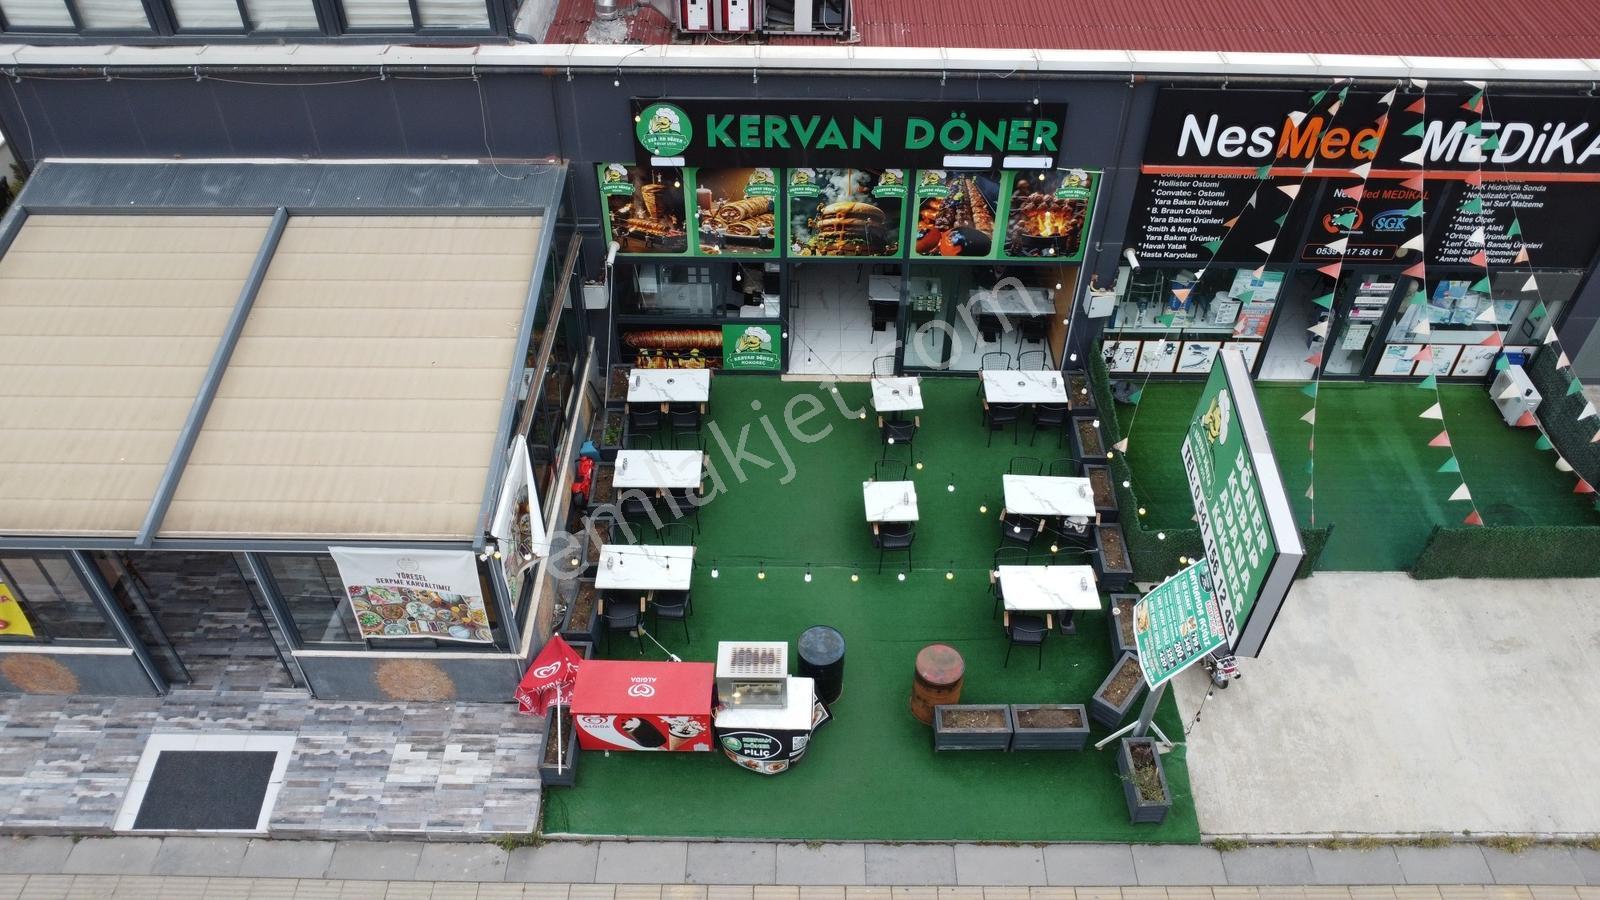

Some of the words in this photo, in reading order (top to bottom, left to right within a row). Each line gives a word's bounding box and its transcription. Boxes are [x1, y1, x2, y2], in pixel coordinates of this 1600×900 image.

[706, 114, 883, 150] KERVAN
[905, 112, 1058, 153] DÖNER
[1198, 198, 1229, 206] Ürünleri
[1194, 216, 1224, 224] Ürünleri
[1375, 217, 1408, 230] SGK
[1190, 234, 1221, 242] Ürünleri
[1486, 241, 1512, 250] Bandaj
[1164, 252, 1198, 260] Karyolası
[1235, 444, 1268, 556] DÖNER
[1228, 468, 1259, 569] KEBAP
[1184, 444, 1196, 486] TEL:
[1194, 485, 1200, 500] 0
[1198, 500, 1209, 535] 541
[1208, 539, 1220, 576] 156
[1218, 579, 1227, 606] 12
[1225, 610, 1234, 636] 48
[1219, 488, 1251, 594] ADANA
[1211, 501, 1244, 616] KOKOREÇ
[744, 749, 770, 758] PİLİÇ
